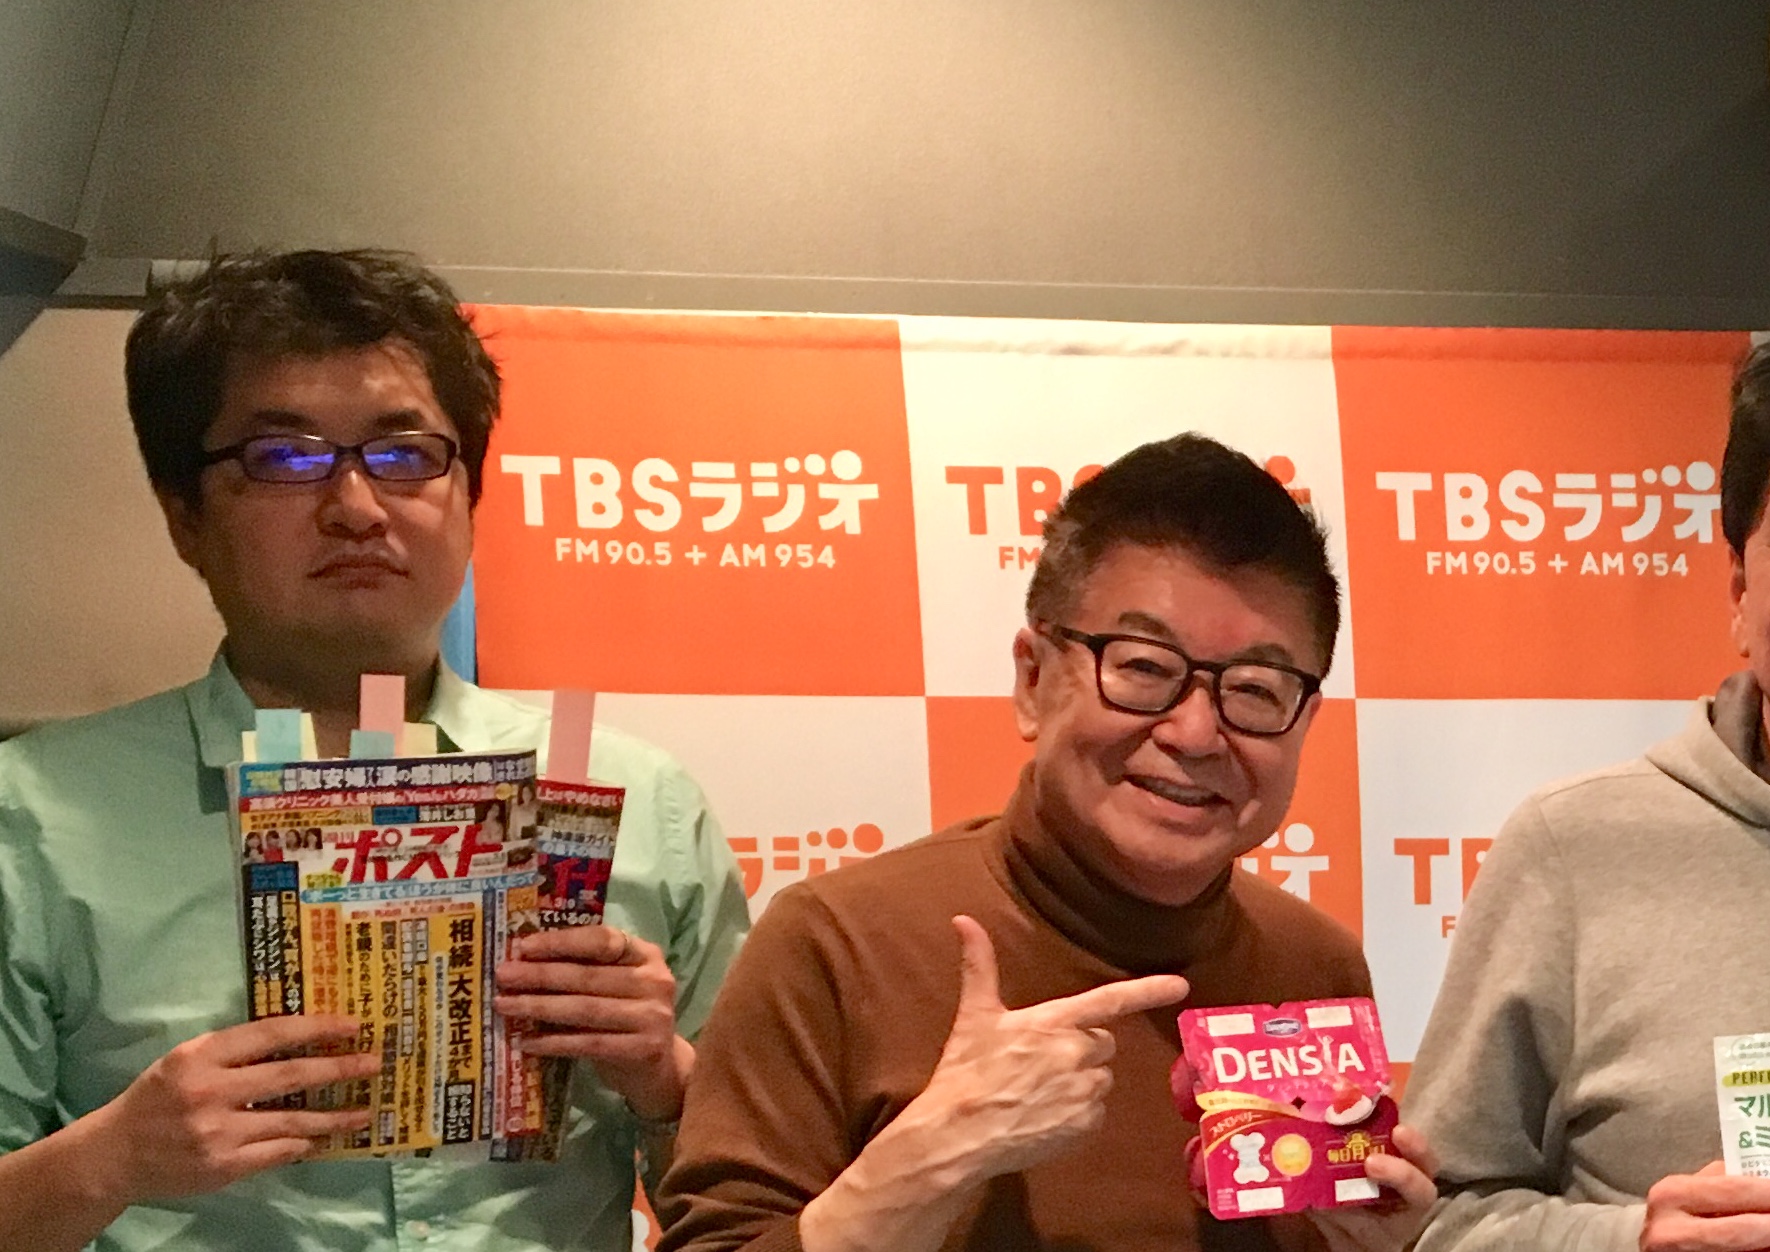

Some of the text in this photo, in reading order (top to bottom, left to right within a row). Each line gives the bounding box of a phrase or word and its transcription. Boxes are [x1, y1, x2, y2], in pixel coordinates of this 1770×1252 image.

[500, 449, 880, 534] TBSラジオ
[331, 823, 504, 883] ポスト
[1211, 1037, 1365, 1084] DENSIA
